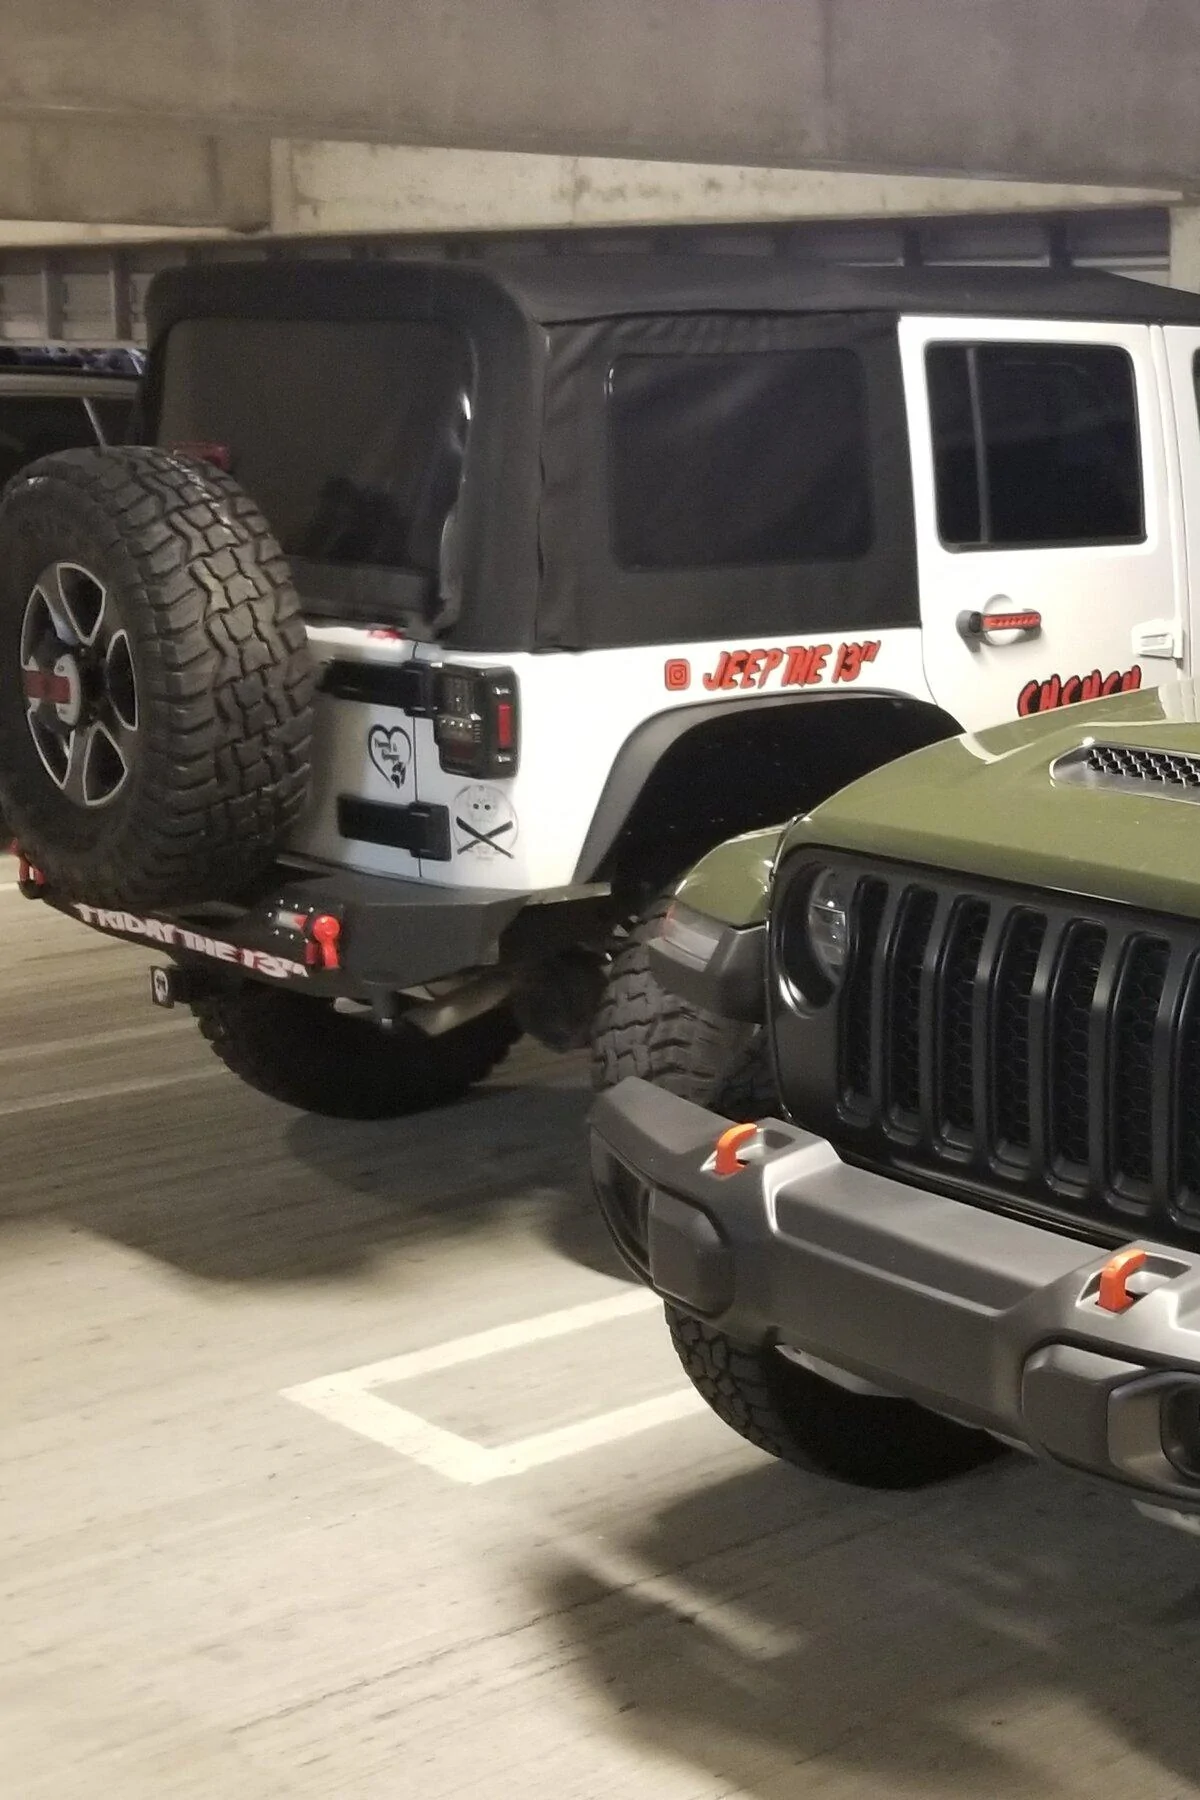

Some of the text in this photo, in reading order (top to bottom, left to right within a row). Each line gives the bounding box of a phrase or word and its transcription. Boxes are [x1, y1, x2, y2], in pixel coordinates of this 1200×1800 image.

[702, 649, 784, 691] JEEP
[781, 644, 832, 687] THE
[72, 903, 176, 944] FRIDAY
[176, 928, 240, 963] THE
